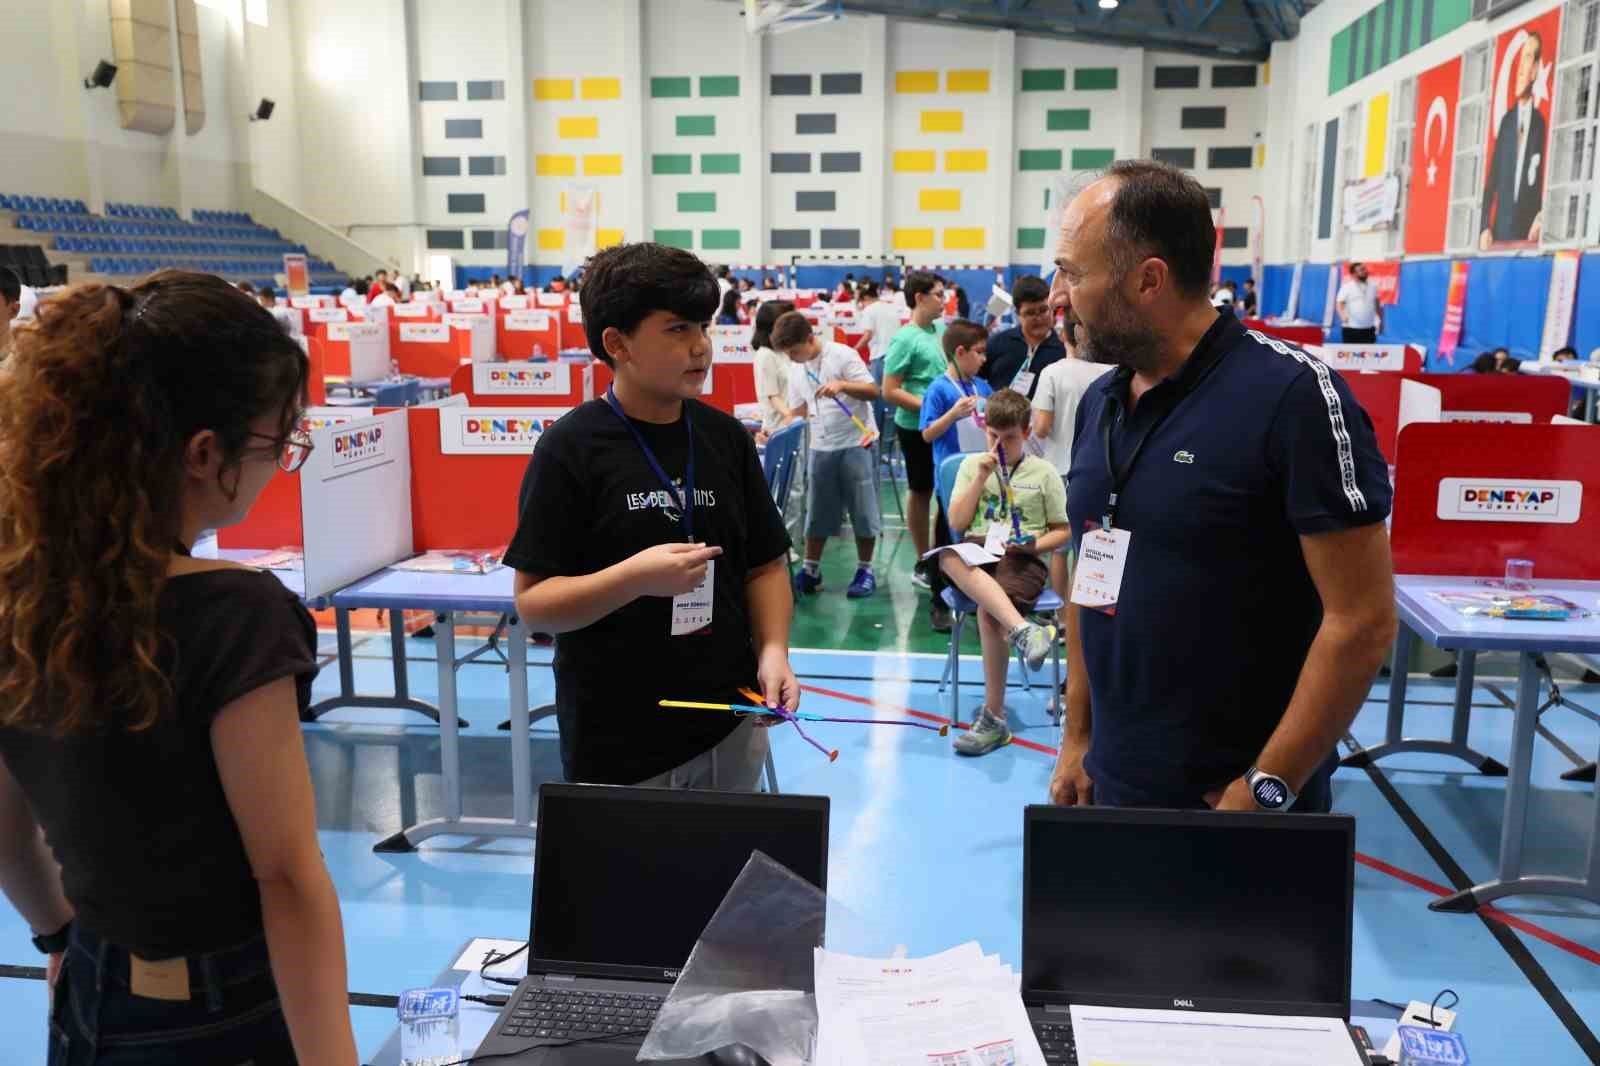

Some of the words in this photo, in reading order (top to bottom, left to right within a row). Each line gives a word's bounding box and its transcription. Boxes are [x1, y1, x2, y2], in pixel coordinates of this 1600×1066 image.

[491, 371, 552, 381] DENEYAP
[335, 428, 382, 453] DENEYAP
[481, 432, 534, 441] TÜRKİY
[626, 492, 647, 511] LES
[1464, 489, 1554, 504] DENEYAP
[1173, 999, 1195, 1008] DELL
